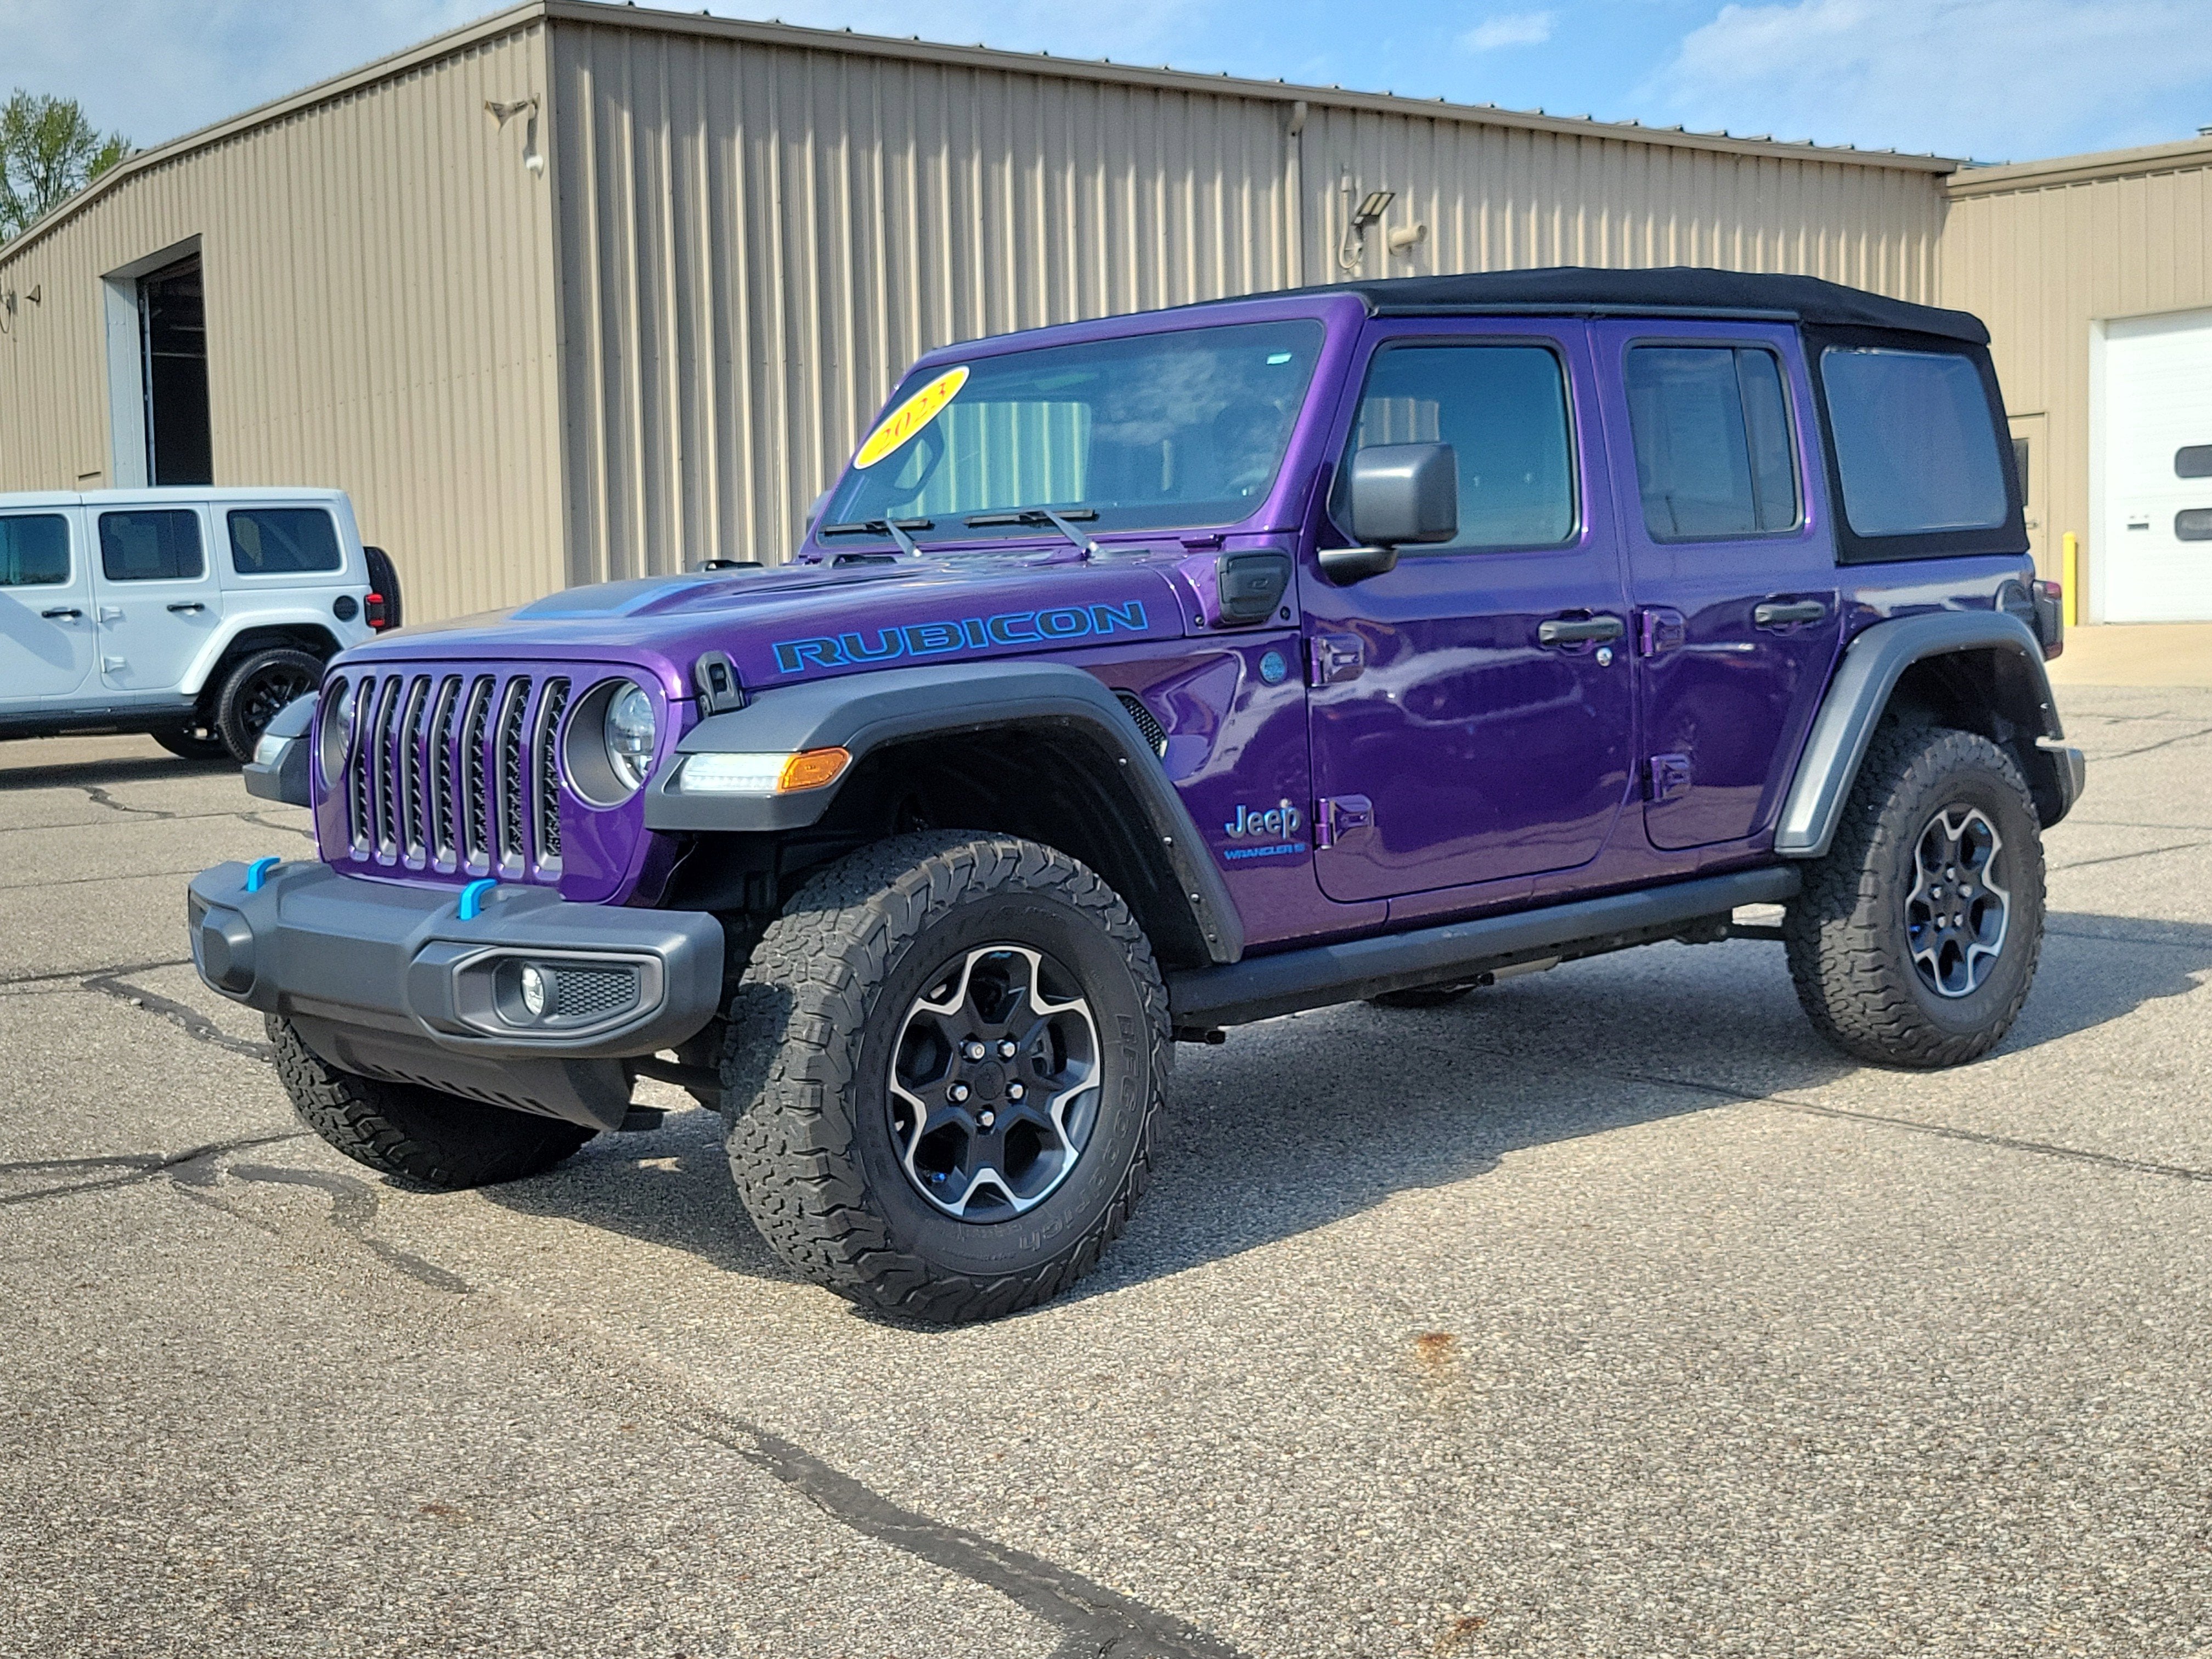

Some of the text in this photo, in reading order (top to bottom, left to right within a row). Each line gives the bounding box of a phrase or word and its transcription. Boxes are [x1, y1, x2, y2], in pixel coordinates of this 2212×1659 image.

[876, 382, 946, 454] 2023
[772, 601, 1148, 673] RUBICON
[1225, 805, 1301, 839] Jeep
